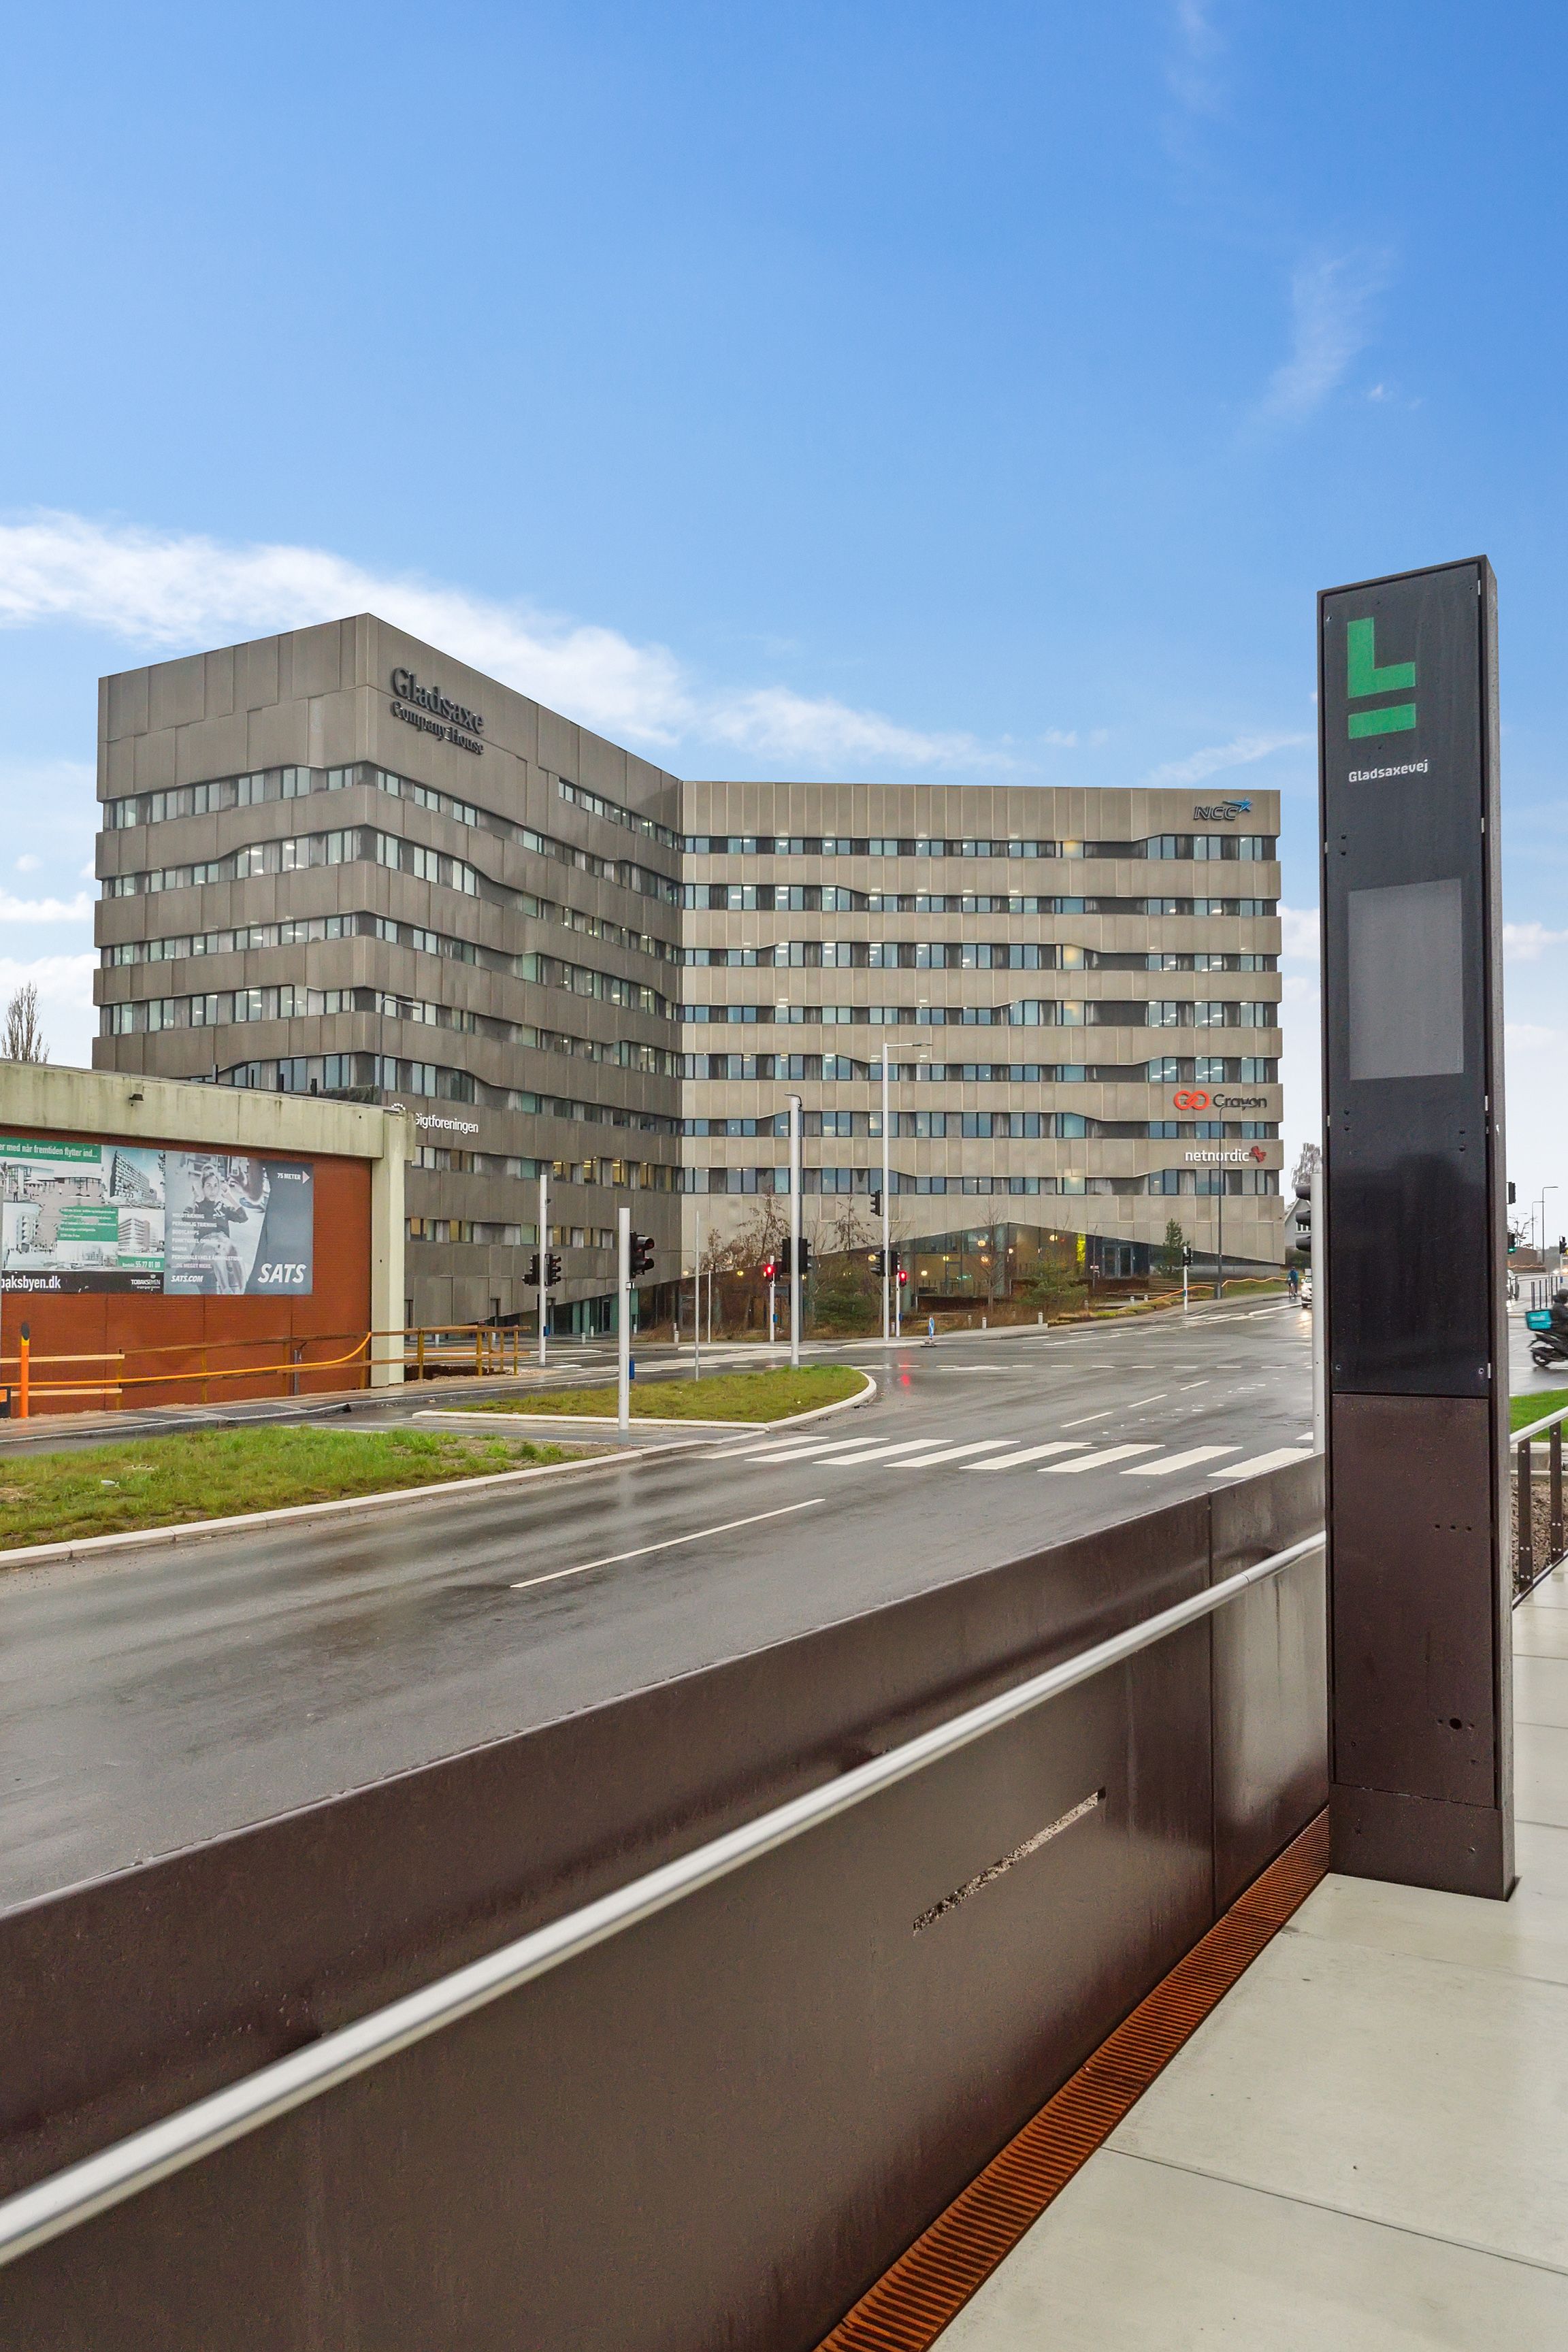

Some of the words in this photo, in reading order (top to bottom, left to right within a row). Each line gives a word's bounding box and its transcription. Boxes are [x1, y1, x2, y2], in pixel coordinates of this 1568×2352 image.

[391, 667, 484, 734] Gladsaxe
[391, 701, 446, 741] Company
[446, 726, 484, 755] House
[1348, 759, 1428, 783] Gladsaxevej
[1194, 806, 1238, 821] NCC
[1213, 1094, 1267, 1111] Crayon
[7, 1143, 20, 1152] med
[22, 1143, 33, 1153] når
[34, 1145, 63, 1155] fremtiden
[65, 1147, 82, 1158] flytter
[1185, 1149, 1250, 1162] netnordic
[171, 1275, 203, 1283] SATS.COM
[257, 1263, 307, 1284] SATS
